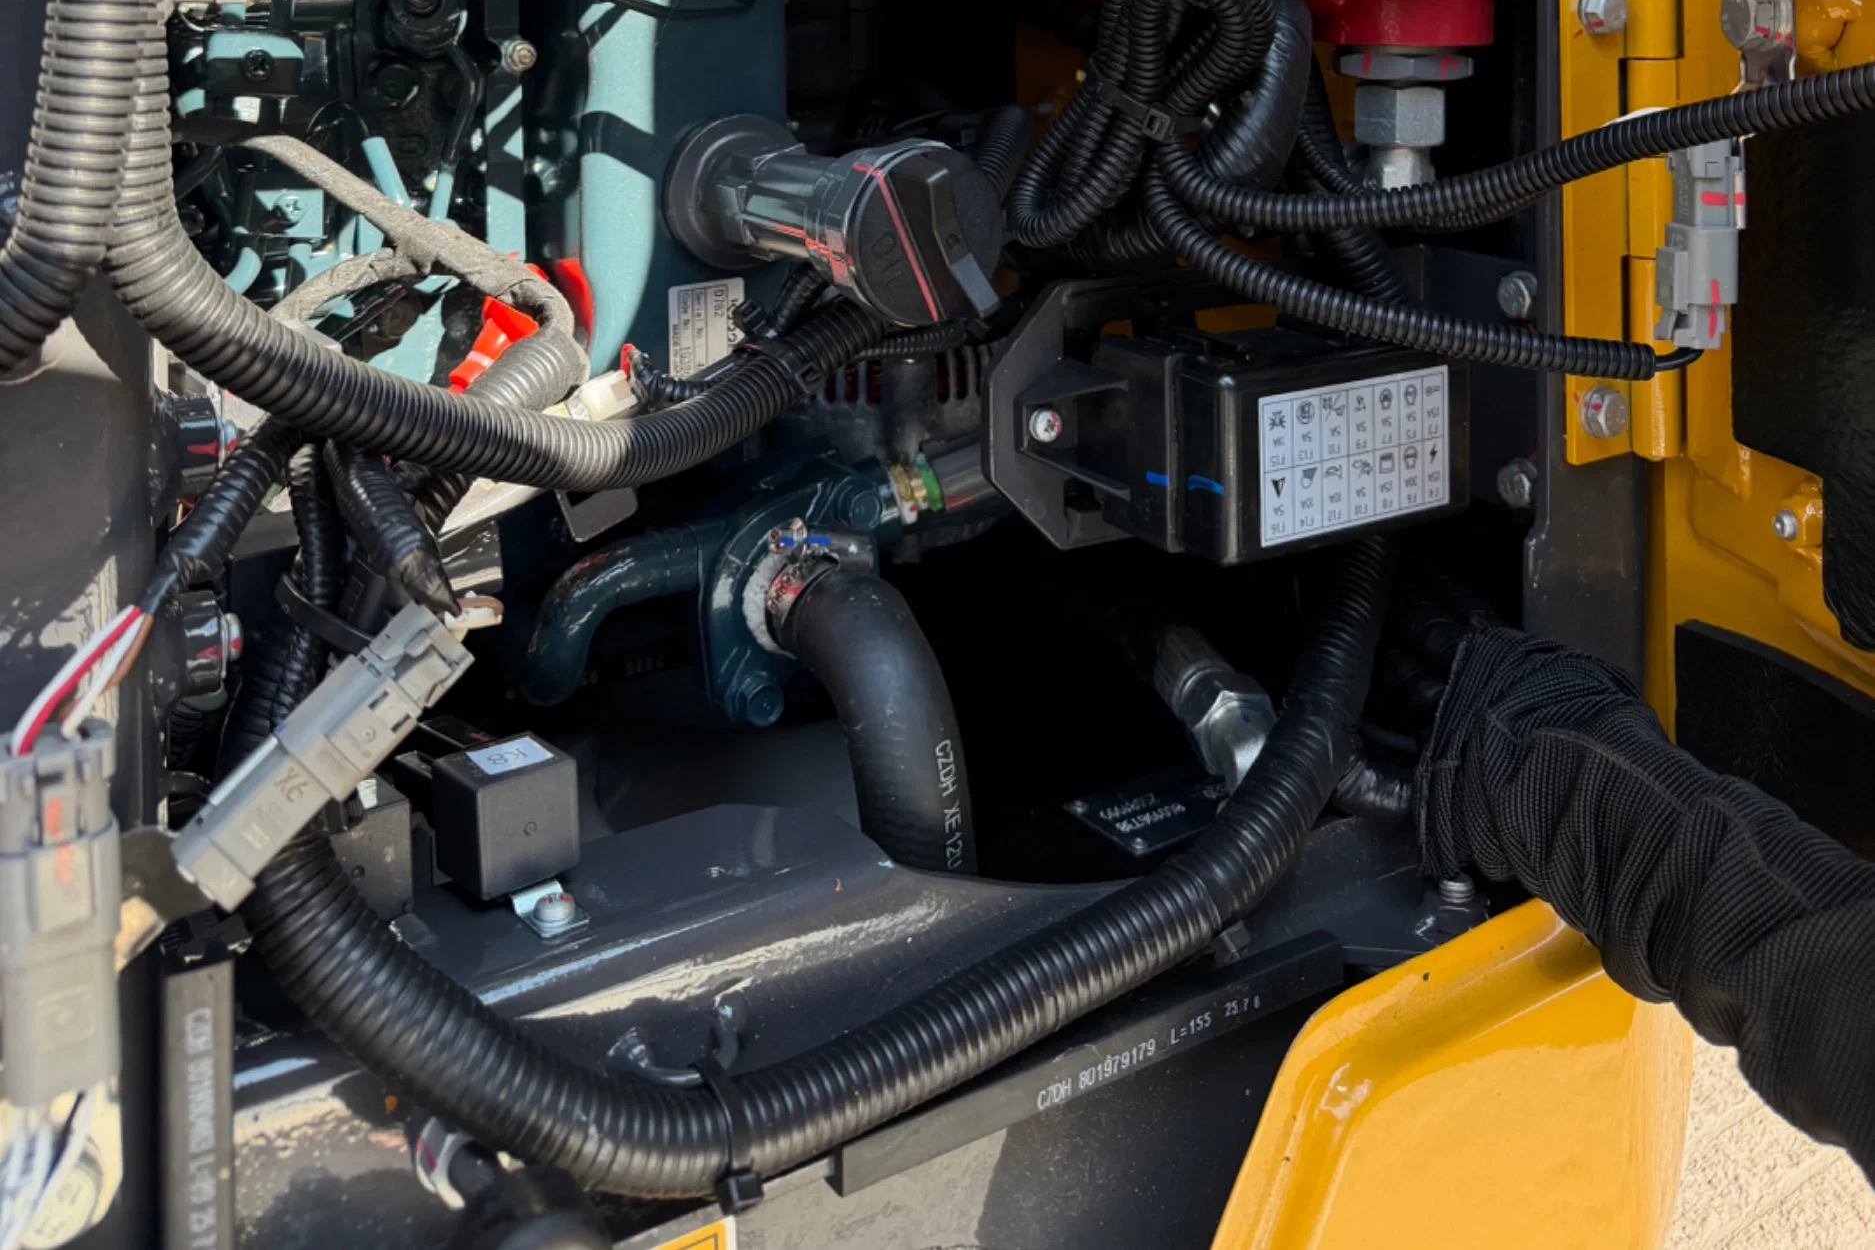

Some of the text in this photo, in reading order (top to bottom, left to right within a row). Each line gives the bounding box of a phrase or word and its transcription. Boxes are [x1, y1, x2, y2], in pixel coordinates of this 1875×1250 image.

[1301, 430, 1313, 443] 5A
[1381, 434, 1393, 445] F7
[1355, 438, 1367, 450] F9
[1269, 455, 1286, 467] F15
[1355, 486, 1366, 498] 5A
[1428, 488, 1440, 499] F4
[1274, 504, 1285, 516] 5A
[1327, 510, 1342, 522] F12
[1300, 515, 1314, 528] F14
[1271, 522, 1286, 535] F16
[934, 739, 958, 797] CZDH
[1036, 1077, 1071, 1110] CZDH
[1078, 1038, 1156, 1090] 801979179
[1170, 1011, 1212, 1045] L=155
